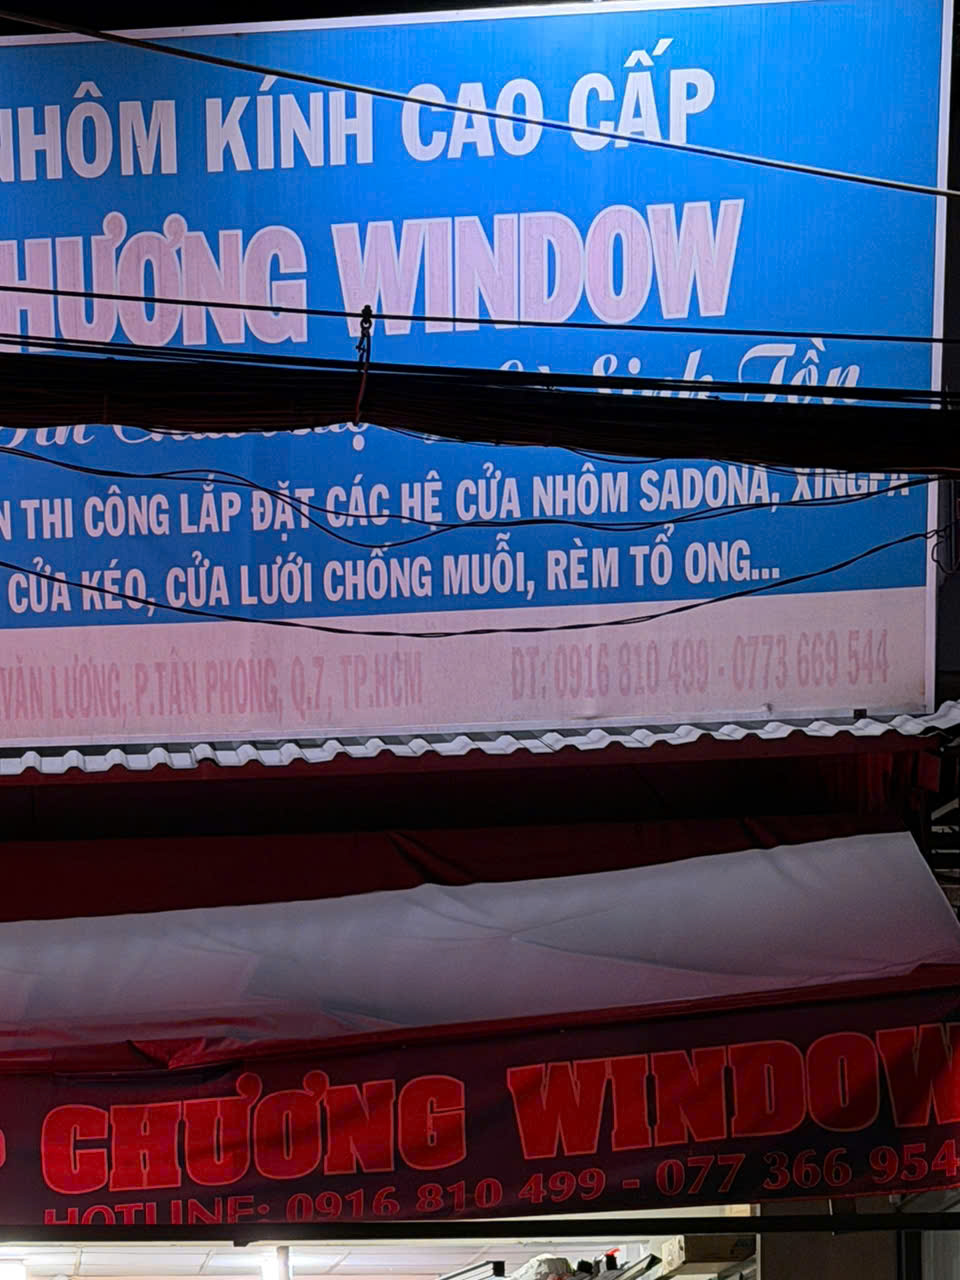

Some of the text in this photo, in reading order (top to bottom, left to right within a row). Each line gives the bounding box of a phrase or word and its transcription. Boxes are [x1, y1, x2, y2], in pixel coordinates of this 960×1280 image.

[207, 73, 373, 173] KÍNH
[402, 78, 543, 161] CAO
[569, 38, 714, 150] CẤP
[332, 199, 745, 336] WINDOW
[21, 497, 74, 539] THI
[84, 486, 170, 537] CÔNG
[180, 474, 241, 534] LẮP
[251, 480, 316, 541] ĐẶT
[327, 473, 390, 527] CÁC
[457, 463, 521, 522] CỬA
[533, 464, 628, 517] NHÔM
[640, 466, 780, 513] SADONA,
[8, 523, 780, 617] CỬA KÉO, CỬA LƯỚI CHỐNG MUỖI, RÈM TỔ ONG...
[0, 656, 43, 720] VĂN
[554, 643, 609, 698] 0916
[618, 640, 659, 696] 810
[667, 638, 709, 693] 499
[729, 634, 787, 690] 0773
[797, 632, 838, 688] 669
[41, 1070, 467, 1194] CHƯƠNG
[507, 1021, 960, 1160] WINDOW
[287, 1186, 400, 1222] 0916
[416, 1178, 503, 1213] 810
[518, 1168, 606, 1205] 499
[656, 1152, 746, 1197] 077
[762, 1147, 852, 1191] 366
